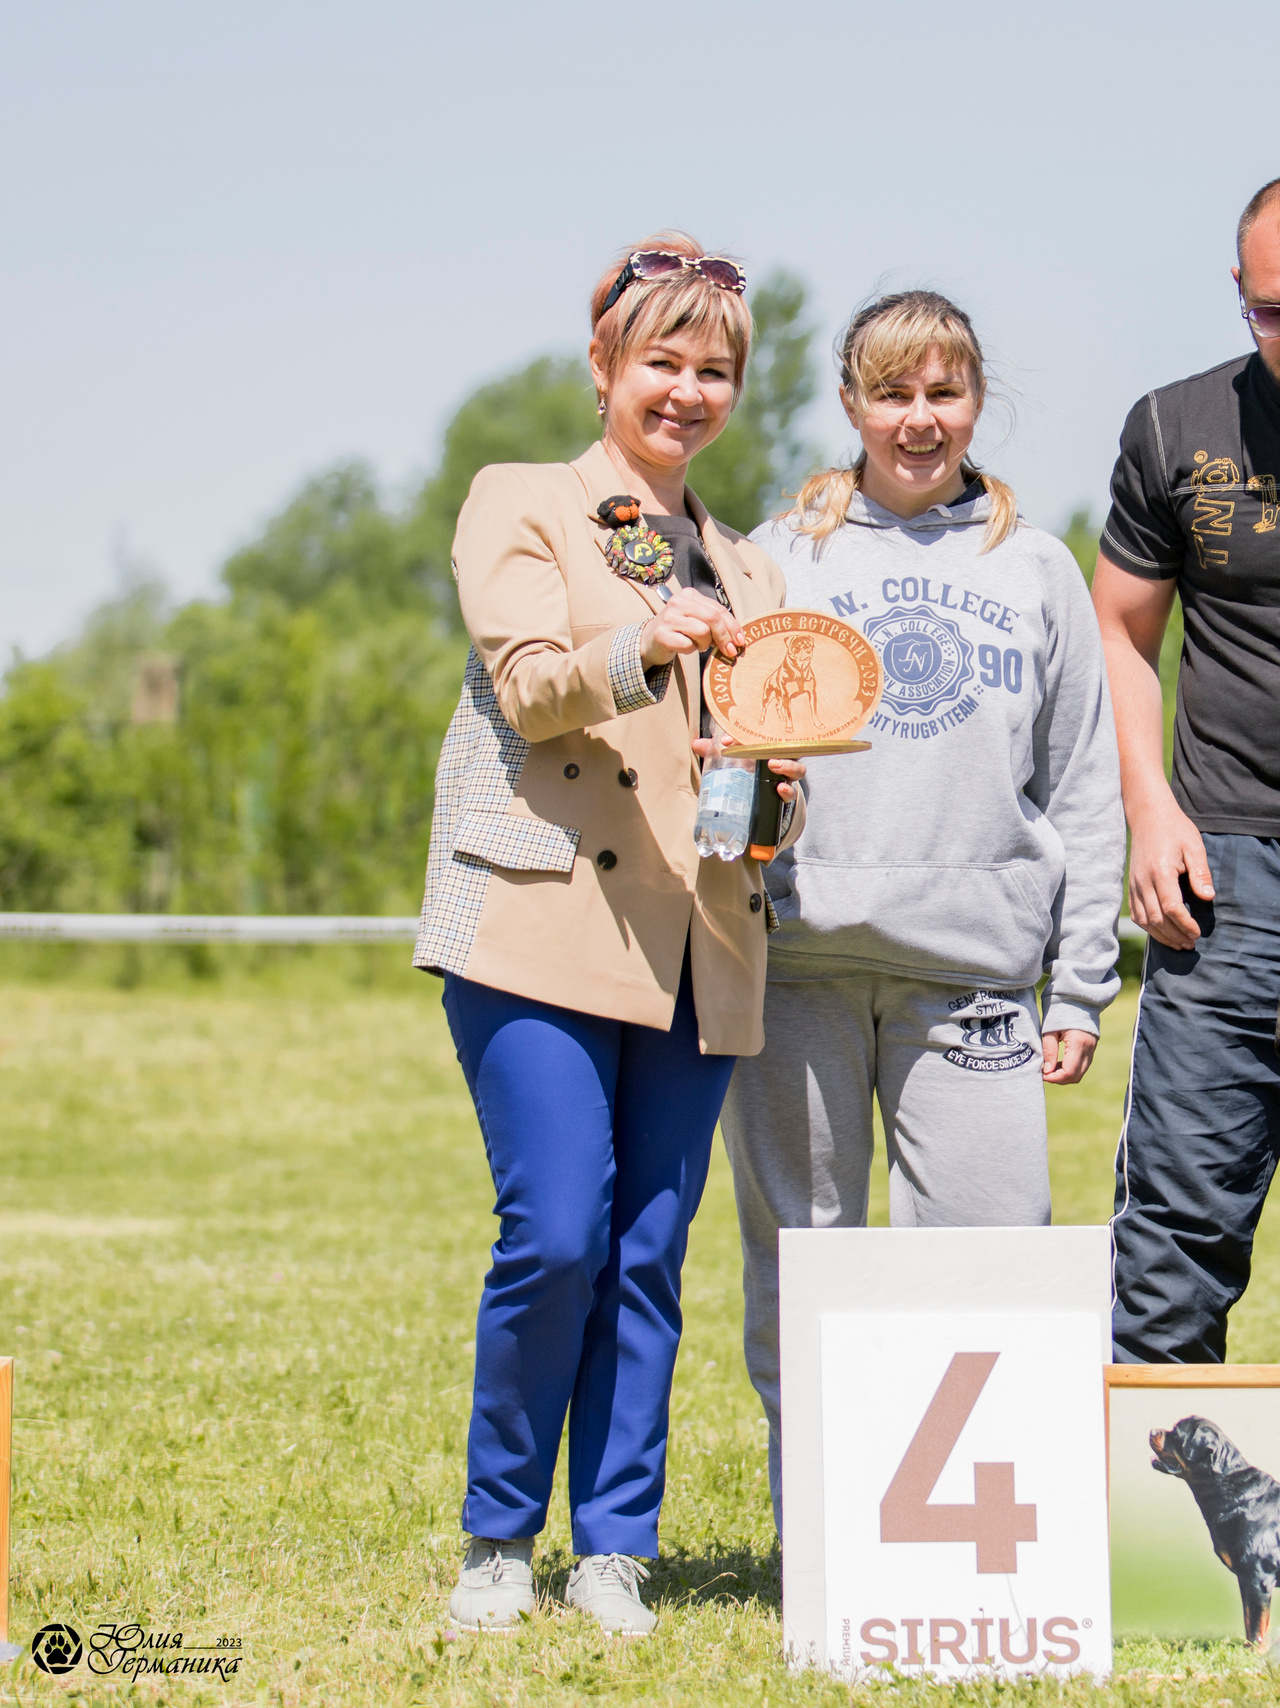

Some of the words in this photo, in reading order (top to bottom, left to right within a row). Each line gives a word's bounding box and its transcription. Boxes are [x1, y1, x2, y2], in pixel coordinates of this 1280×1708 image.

[882, 576, 1021, 635] COLLEGE
[899, 620, 952, 648] COLLEGE
[714, 615, 792, 705] ВОРОСКИЕ
[799, 615, 867, 660] ВСТРЕЧИ
[860, 661, 877, 698] 2023
[898, 658, 956, 697] ASSOCIATION
[978, 643, 1023, 694] 90
[975, 1001, 1007, 1016] STYLE
[947, 1049, 967, 1065] EYE
[966, 1056, 999, 1071] FORCE
[880, 1352, 1038, 1574] 4
[841, 1618, 851, 1667] PREMIUM
[860, 1616, 1081, 1665] SIRIUS
